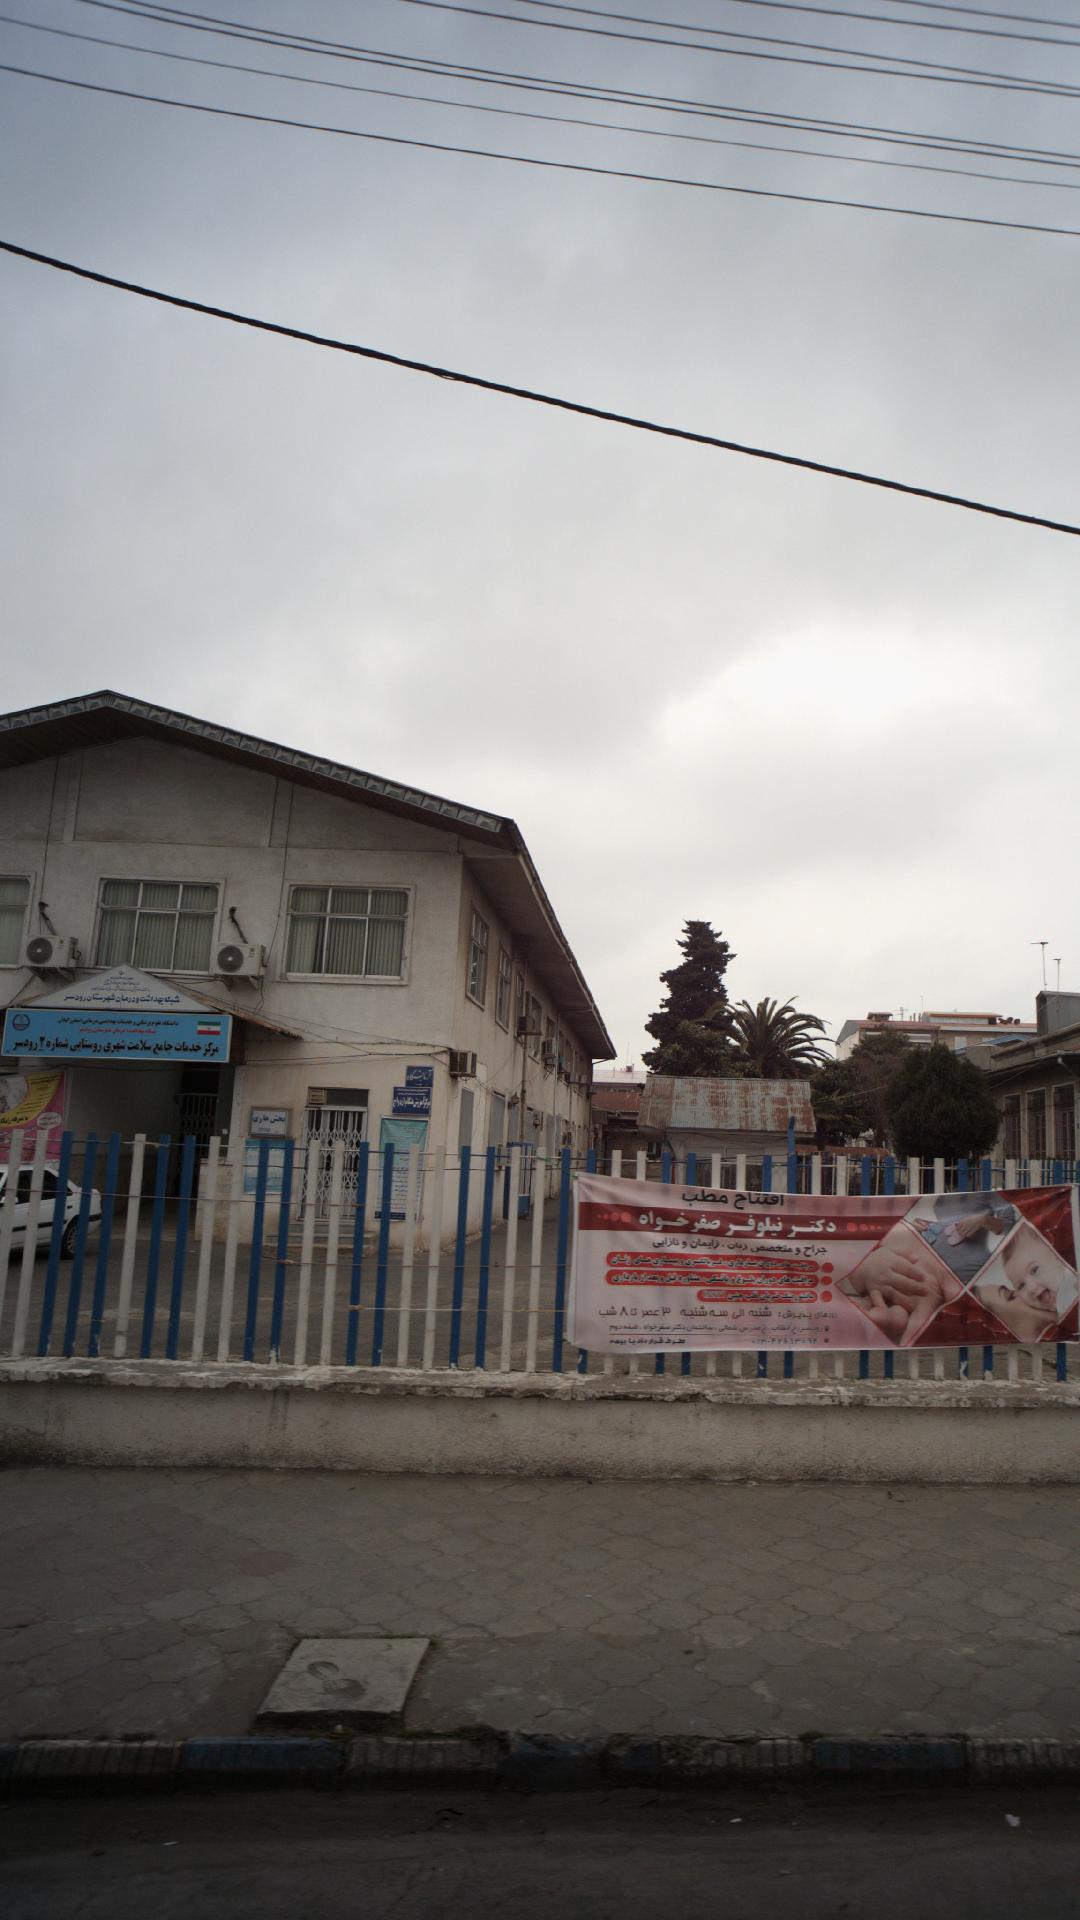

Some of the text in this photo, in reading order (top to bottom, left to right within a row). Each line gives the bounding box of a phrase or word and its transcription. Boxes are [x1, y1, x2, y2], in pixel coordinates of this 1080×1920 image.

[87, 993, 115, 1003] شهرستان
[140, 994, 164, 1005] بهداشت
[165, 994, 180, 1004] شبکه
[13, 1038, 38, 1051] رودسر
[46, 1036, 68, 1051] شماره
[70, 1037, 102, 1053] روستایی
[103, 1038, 125, 1053] شهری
[127, 1039, 151, 1052] سلامت
[153, 1040, 173, 1055] جامع
[175, 1040, 202, 1053] خدمات
[203, 1042, 219, 1056] مرکز
[270, 1113, 285, 1123] بخش
[682, 1189, 784, 1210] افتتاح مطب
[725, 1214, 783, 1238] نیلوفر
[787, 1218, 837, 1238] دکتر
[652, 1237, 679, 1248] نازایی
[682, 1240, 687, 1248] و
[689, 1238, 720, 1249] زایمان
[750, 1242, 793, 1253] متخصص
[795, 1247, 801, 1255] و
[803, 1245, 827, 1257] جراح
[598, 1306, 617, 1318] شب
[619, 1306, 628, 1316] ۸
[630, 1308, 638, 1316] تا
[642, 1309, 660, 1318] عصر
[662, 1307, 671, 1317] ۳
[680, 1306, 708, 1319] شنبه
[709, 1309, 728, 1317] سه
[732, 1309, 745, 1319] الی
[748, 1306, 772, 1319] شنبه
